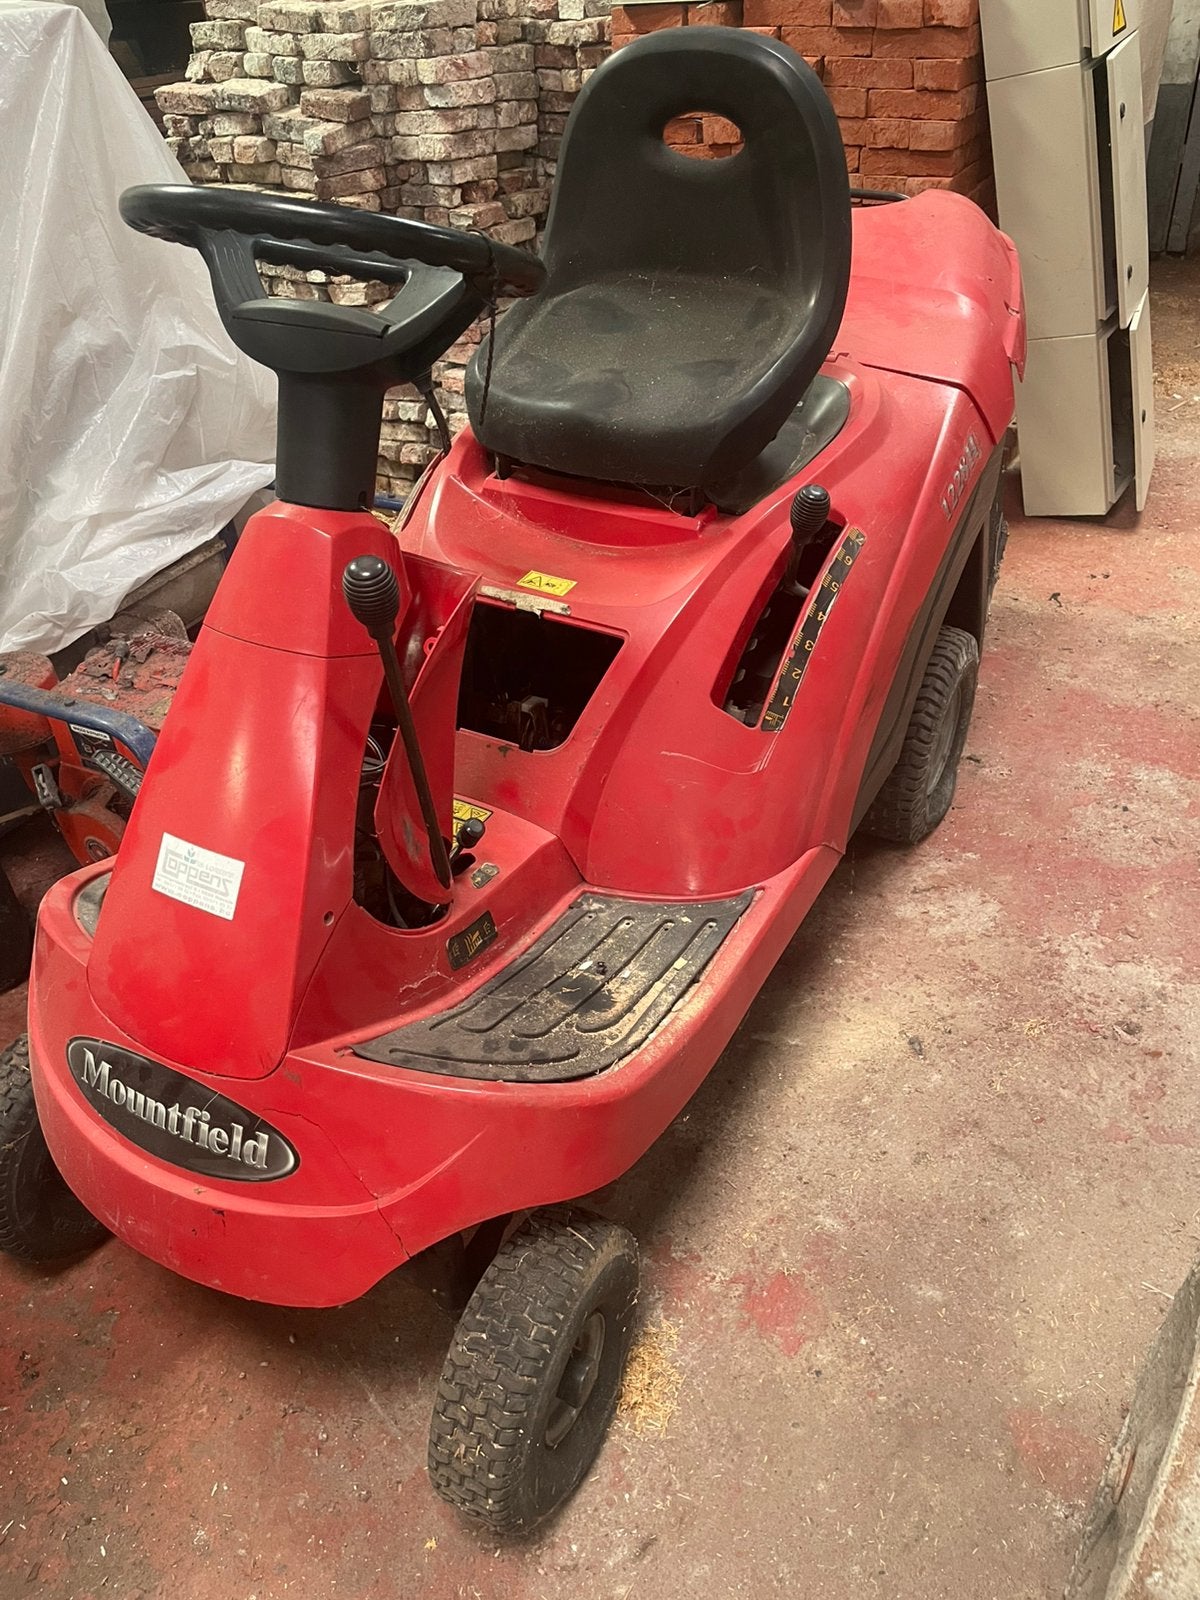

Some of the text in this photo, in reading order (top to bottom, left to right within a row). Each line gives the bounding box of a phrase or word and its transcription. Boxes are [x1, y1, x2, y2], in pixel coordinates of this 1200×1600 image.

[844, 555, 853, 566] 6
[830, 581, 840, 593] 5
[817, 611, 827, 622] 4
[804, 640, 815, 651] 3
[792, 667, 802, 679] 2
[782, 696, 790, 707] 1
[81, 1047, 270, 1168] Mountfield
